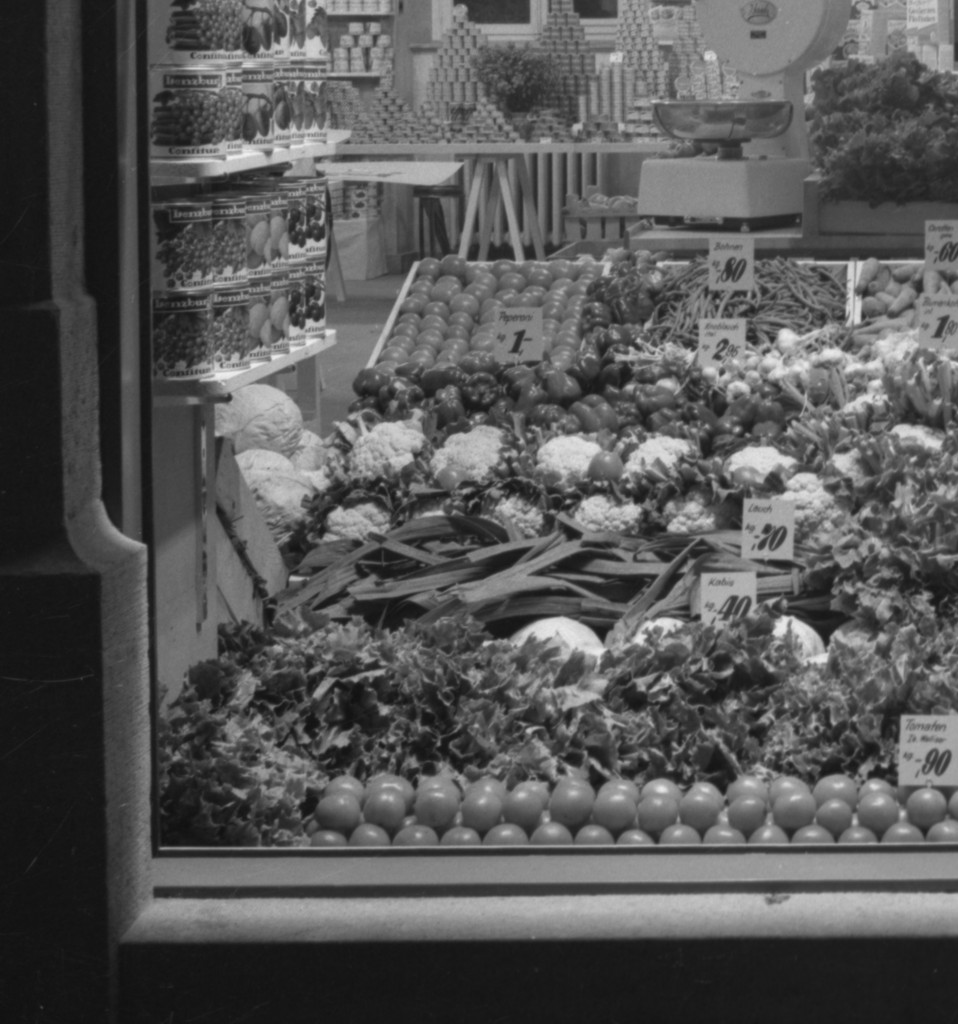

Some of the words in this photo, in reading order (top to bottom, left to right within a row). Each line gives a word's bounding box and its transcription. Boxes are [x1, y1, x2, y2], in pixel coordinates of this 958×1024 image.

[747, 503, 774, 514] Lauch
[708, 577, 735, 588] Kabis
[905, 718, 948, 732] Tomaten
